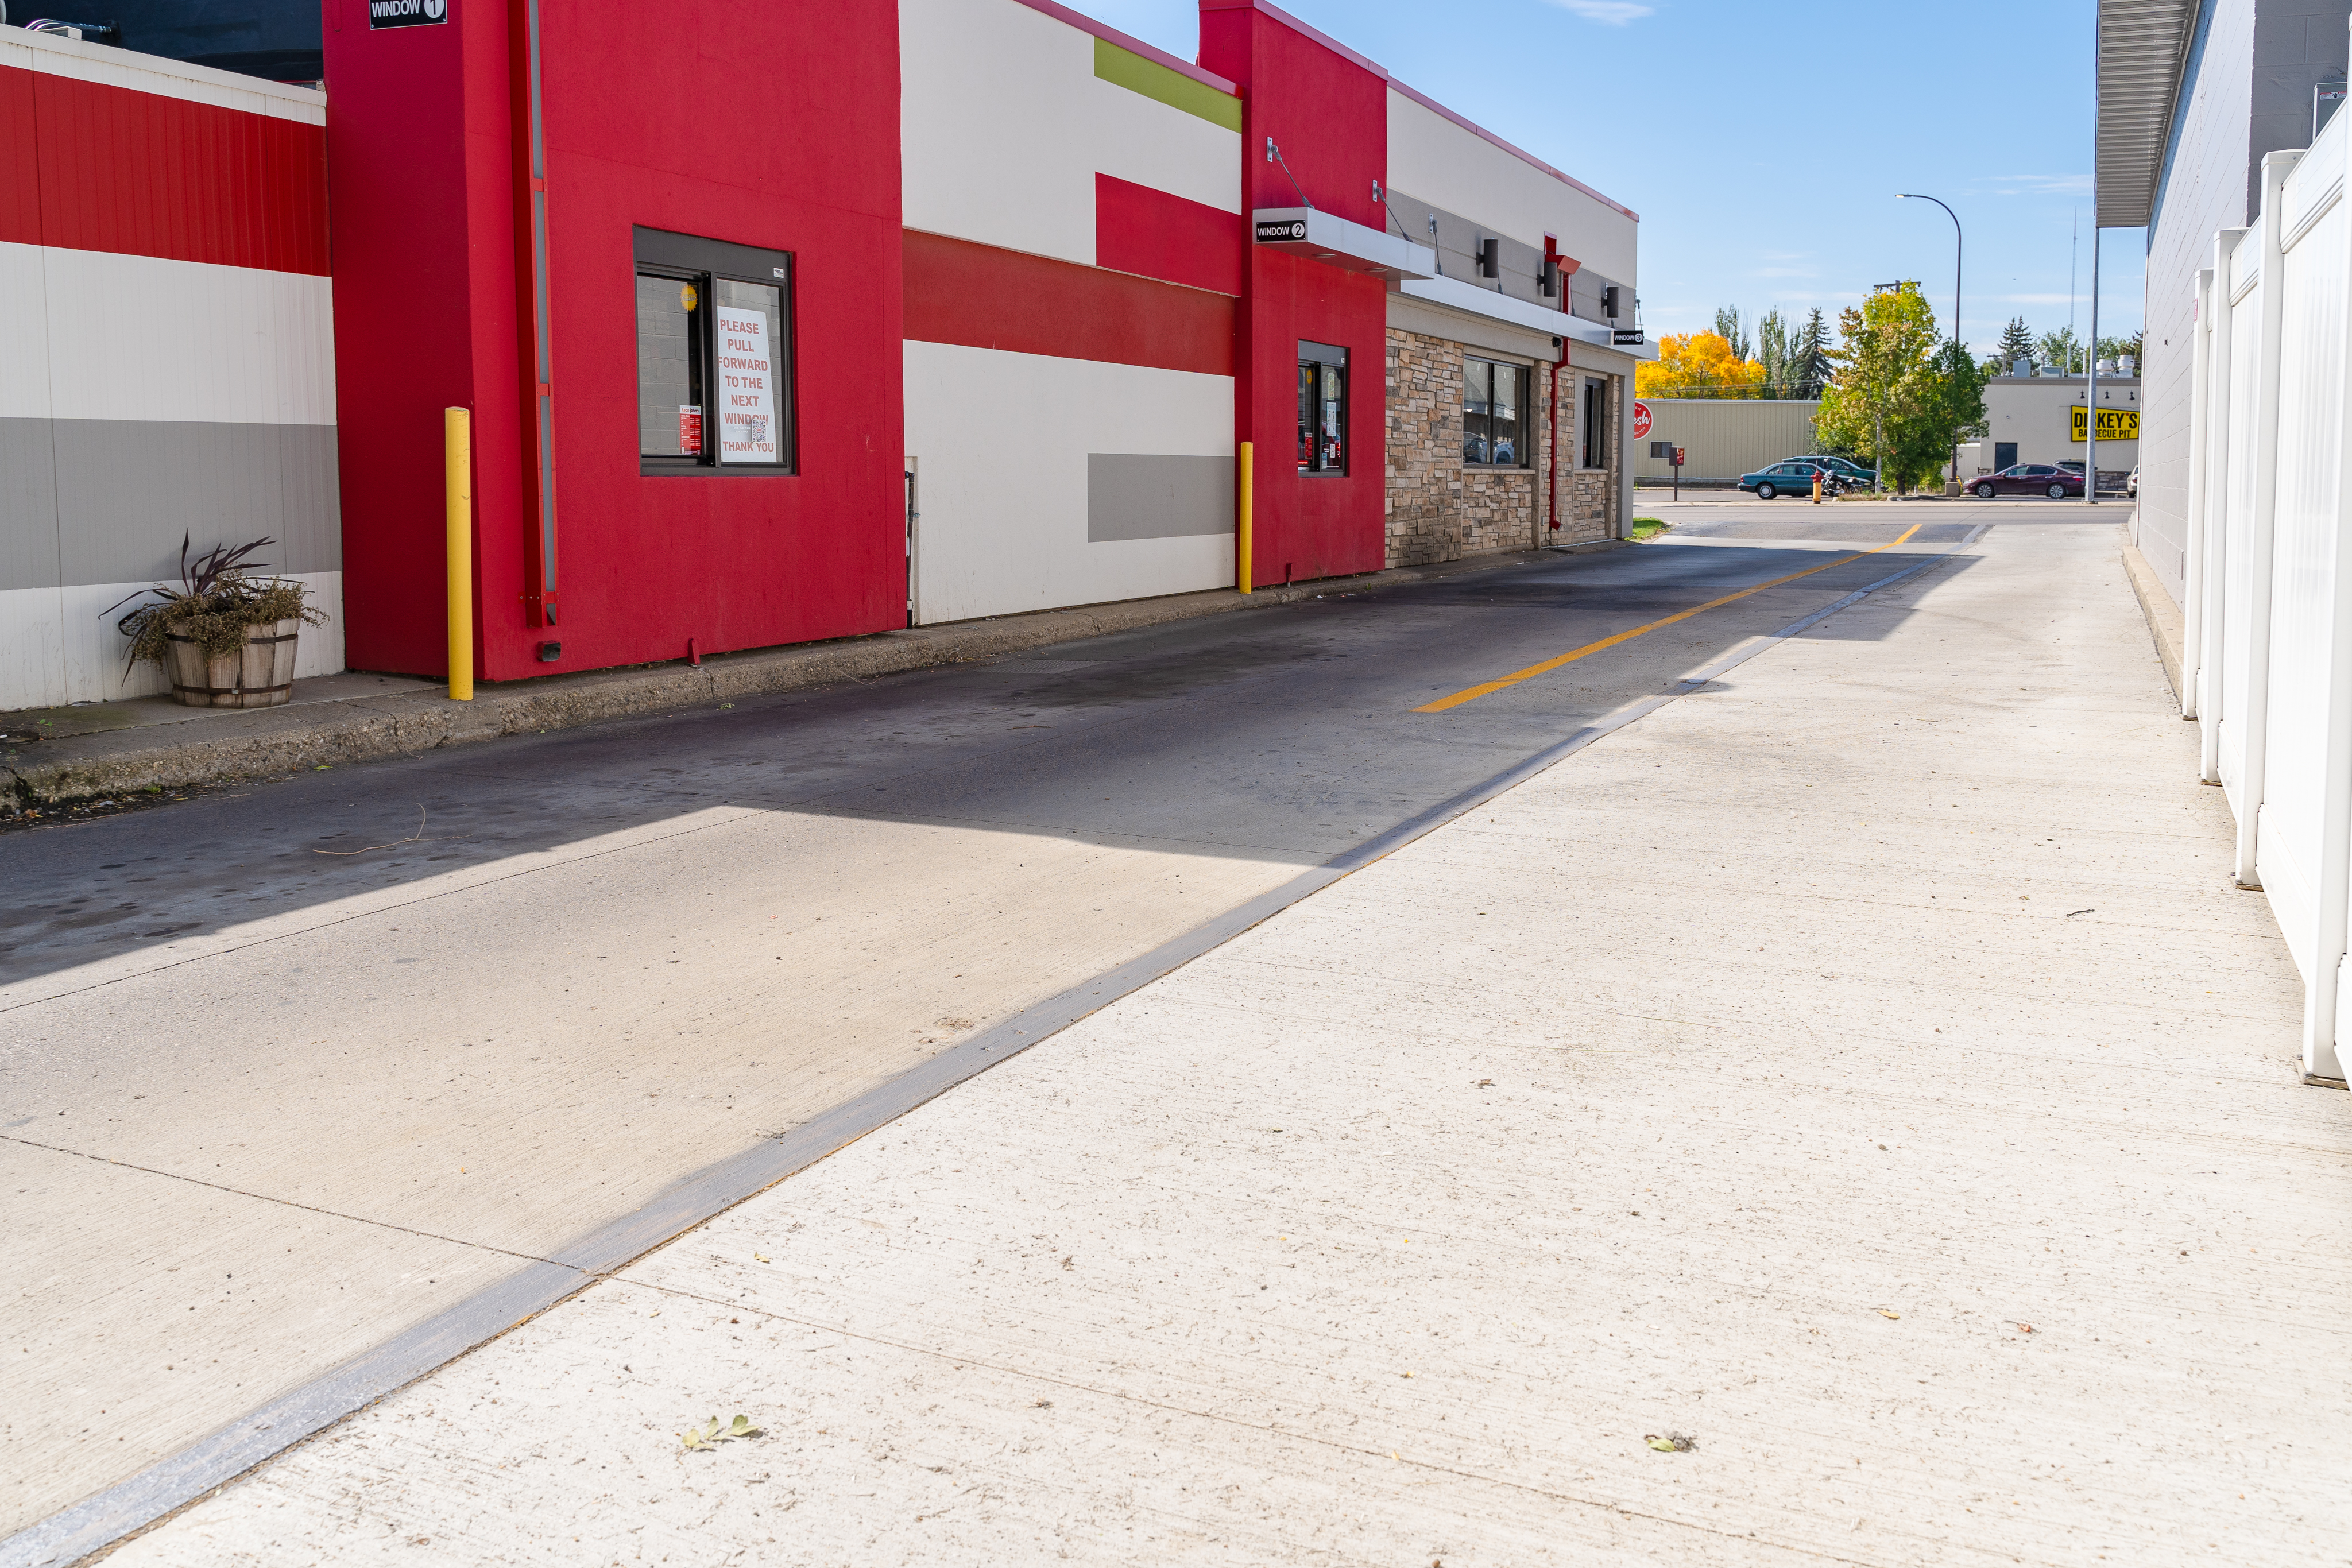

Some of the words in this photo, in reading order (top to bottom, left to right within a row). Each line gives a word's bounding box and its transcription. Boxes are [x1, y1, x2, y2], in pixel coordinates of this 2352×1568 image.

[372, 0, 420, 17] WINDOW
[1258, 227, 1290, 236] WINDOW
[720, 319, 759, 334] PLEASE
[728, 339, 754, 352] PULL
[718, 356, 768, 371] FORWARD
[725, 375, 739, 388] TO
[741, 377, 763, 389] THE
[731, 394, 759, 407] NEXT
[2074, 412, 2137, 429] DIKEY'S
[2079, 429, 2117, 438] BABECUE
[2119, 429, 2131, 438] PIT
[722, 441, 754, 451] THANK
[756, 442, 774, 452] YOU
